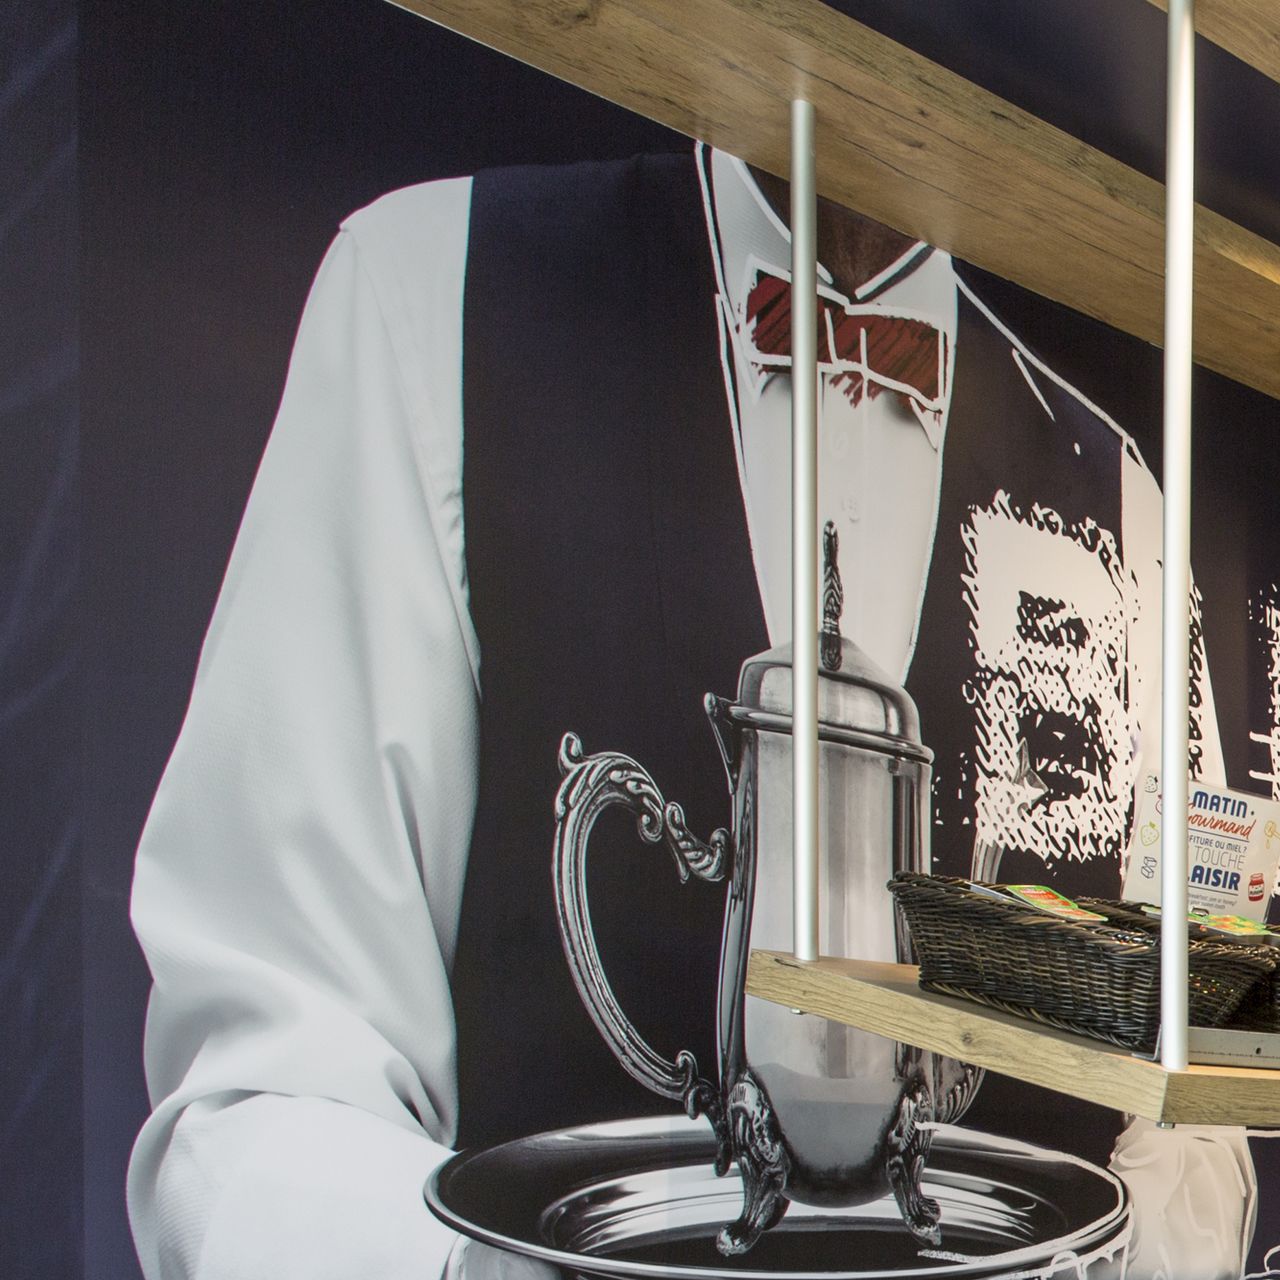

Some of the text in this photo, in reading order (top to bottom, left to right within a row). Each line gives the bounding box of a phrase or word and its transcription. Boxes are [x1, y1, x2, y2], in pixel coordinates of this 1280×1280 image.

[1193, 790, 1248, 819] MATIN
[1189, 834, 1214, 848] FITURE
[1214, 840, 1226, 850] OU
[1226, 842, 1242, 853] MIEL
[1194, 845, 1246, 871] TOUCHE
[1188, 865, 1241, 891] AISIR
